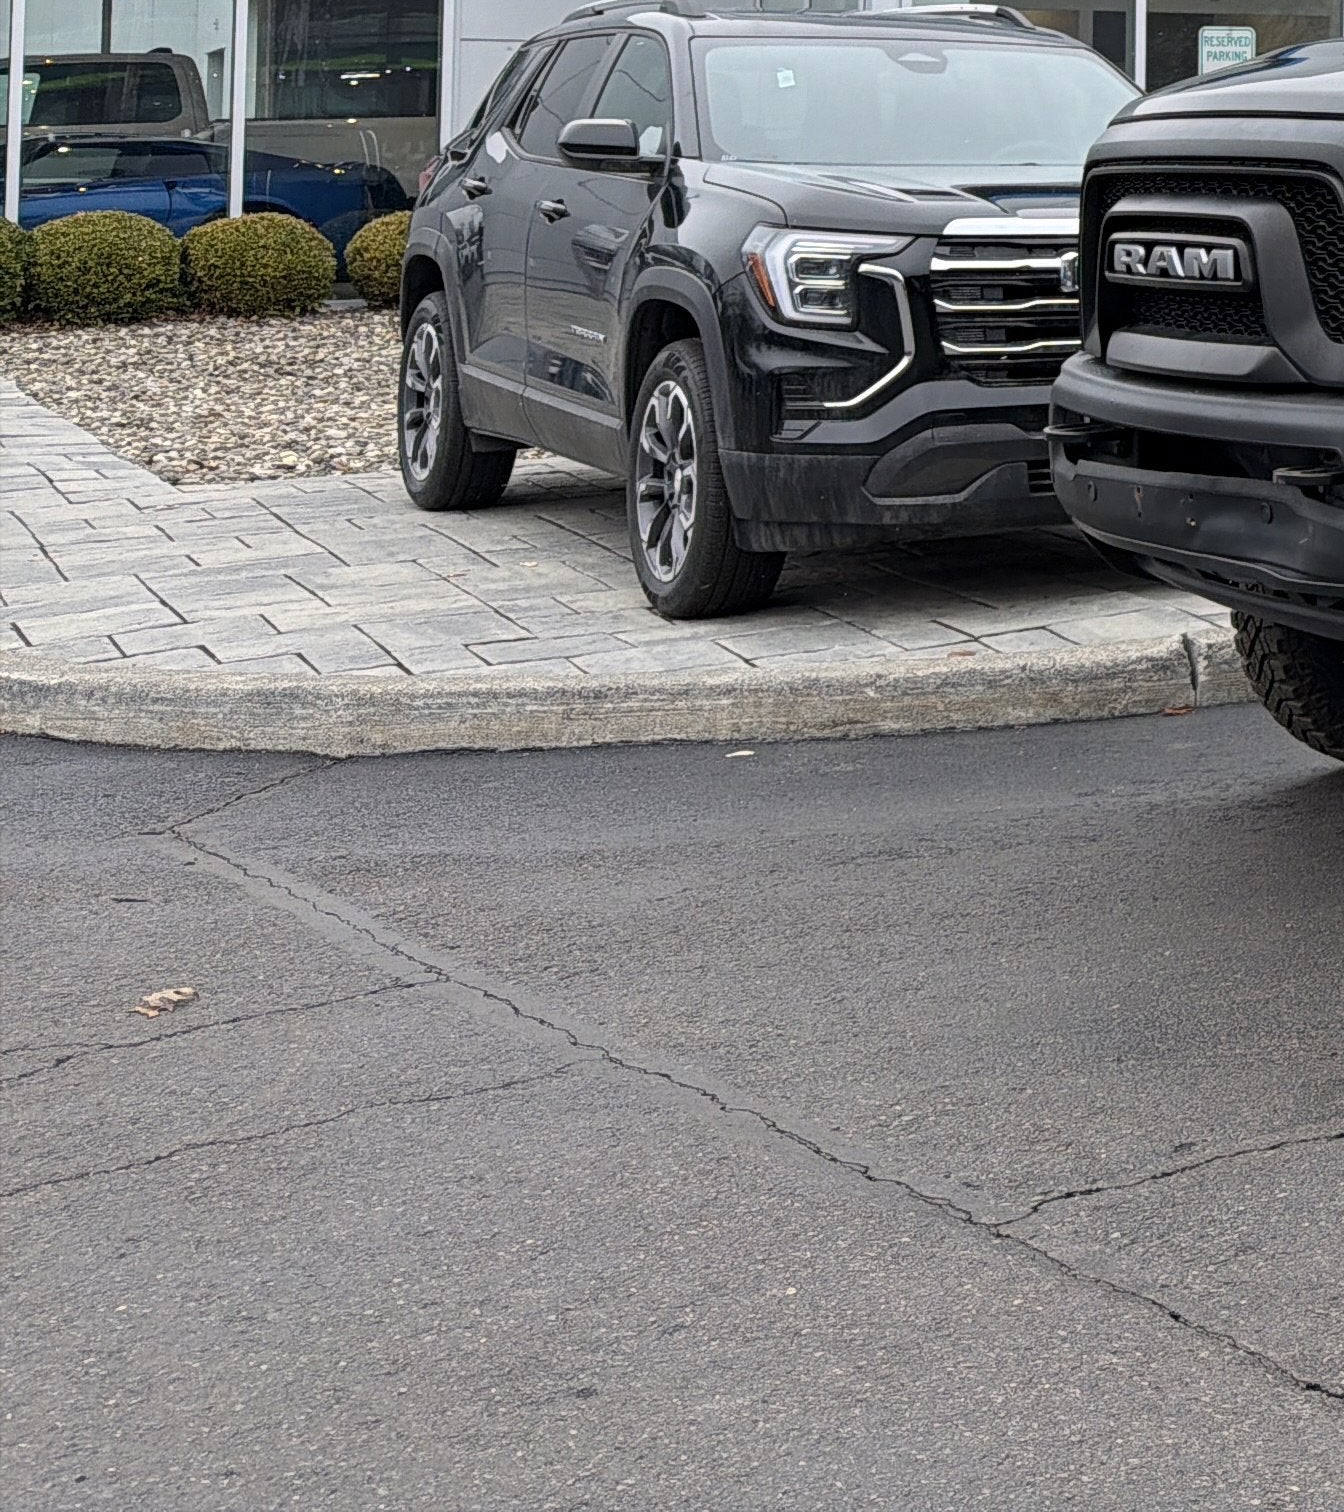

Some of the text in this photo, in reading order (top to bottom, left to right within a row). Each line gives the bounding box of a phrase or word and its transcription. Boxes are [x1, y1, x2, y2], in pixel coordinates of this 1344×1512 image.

[1203, 35, 1251, 48] RESERVED
[1206, 50, 1248, 62] PARKING
[1112, 242, 1235, 281] RAM
